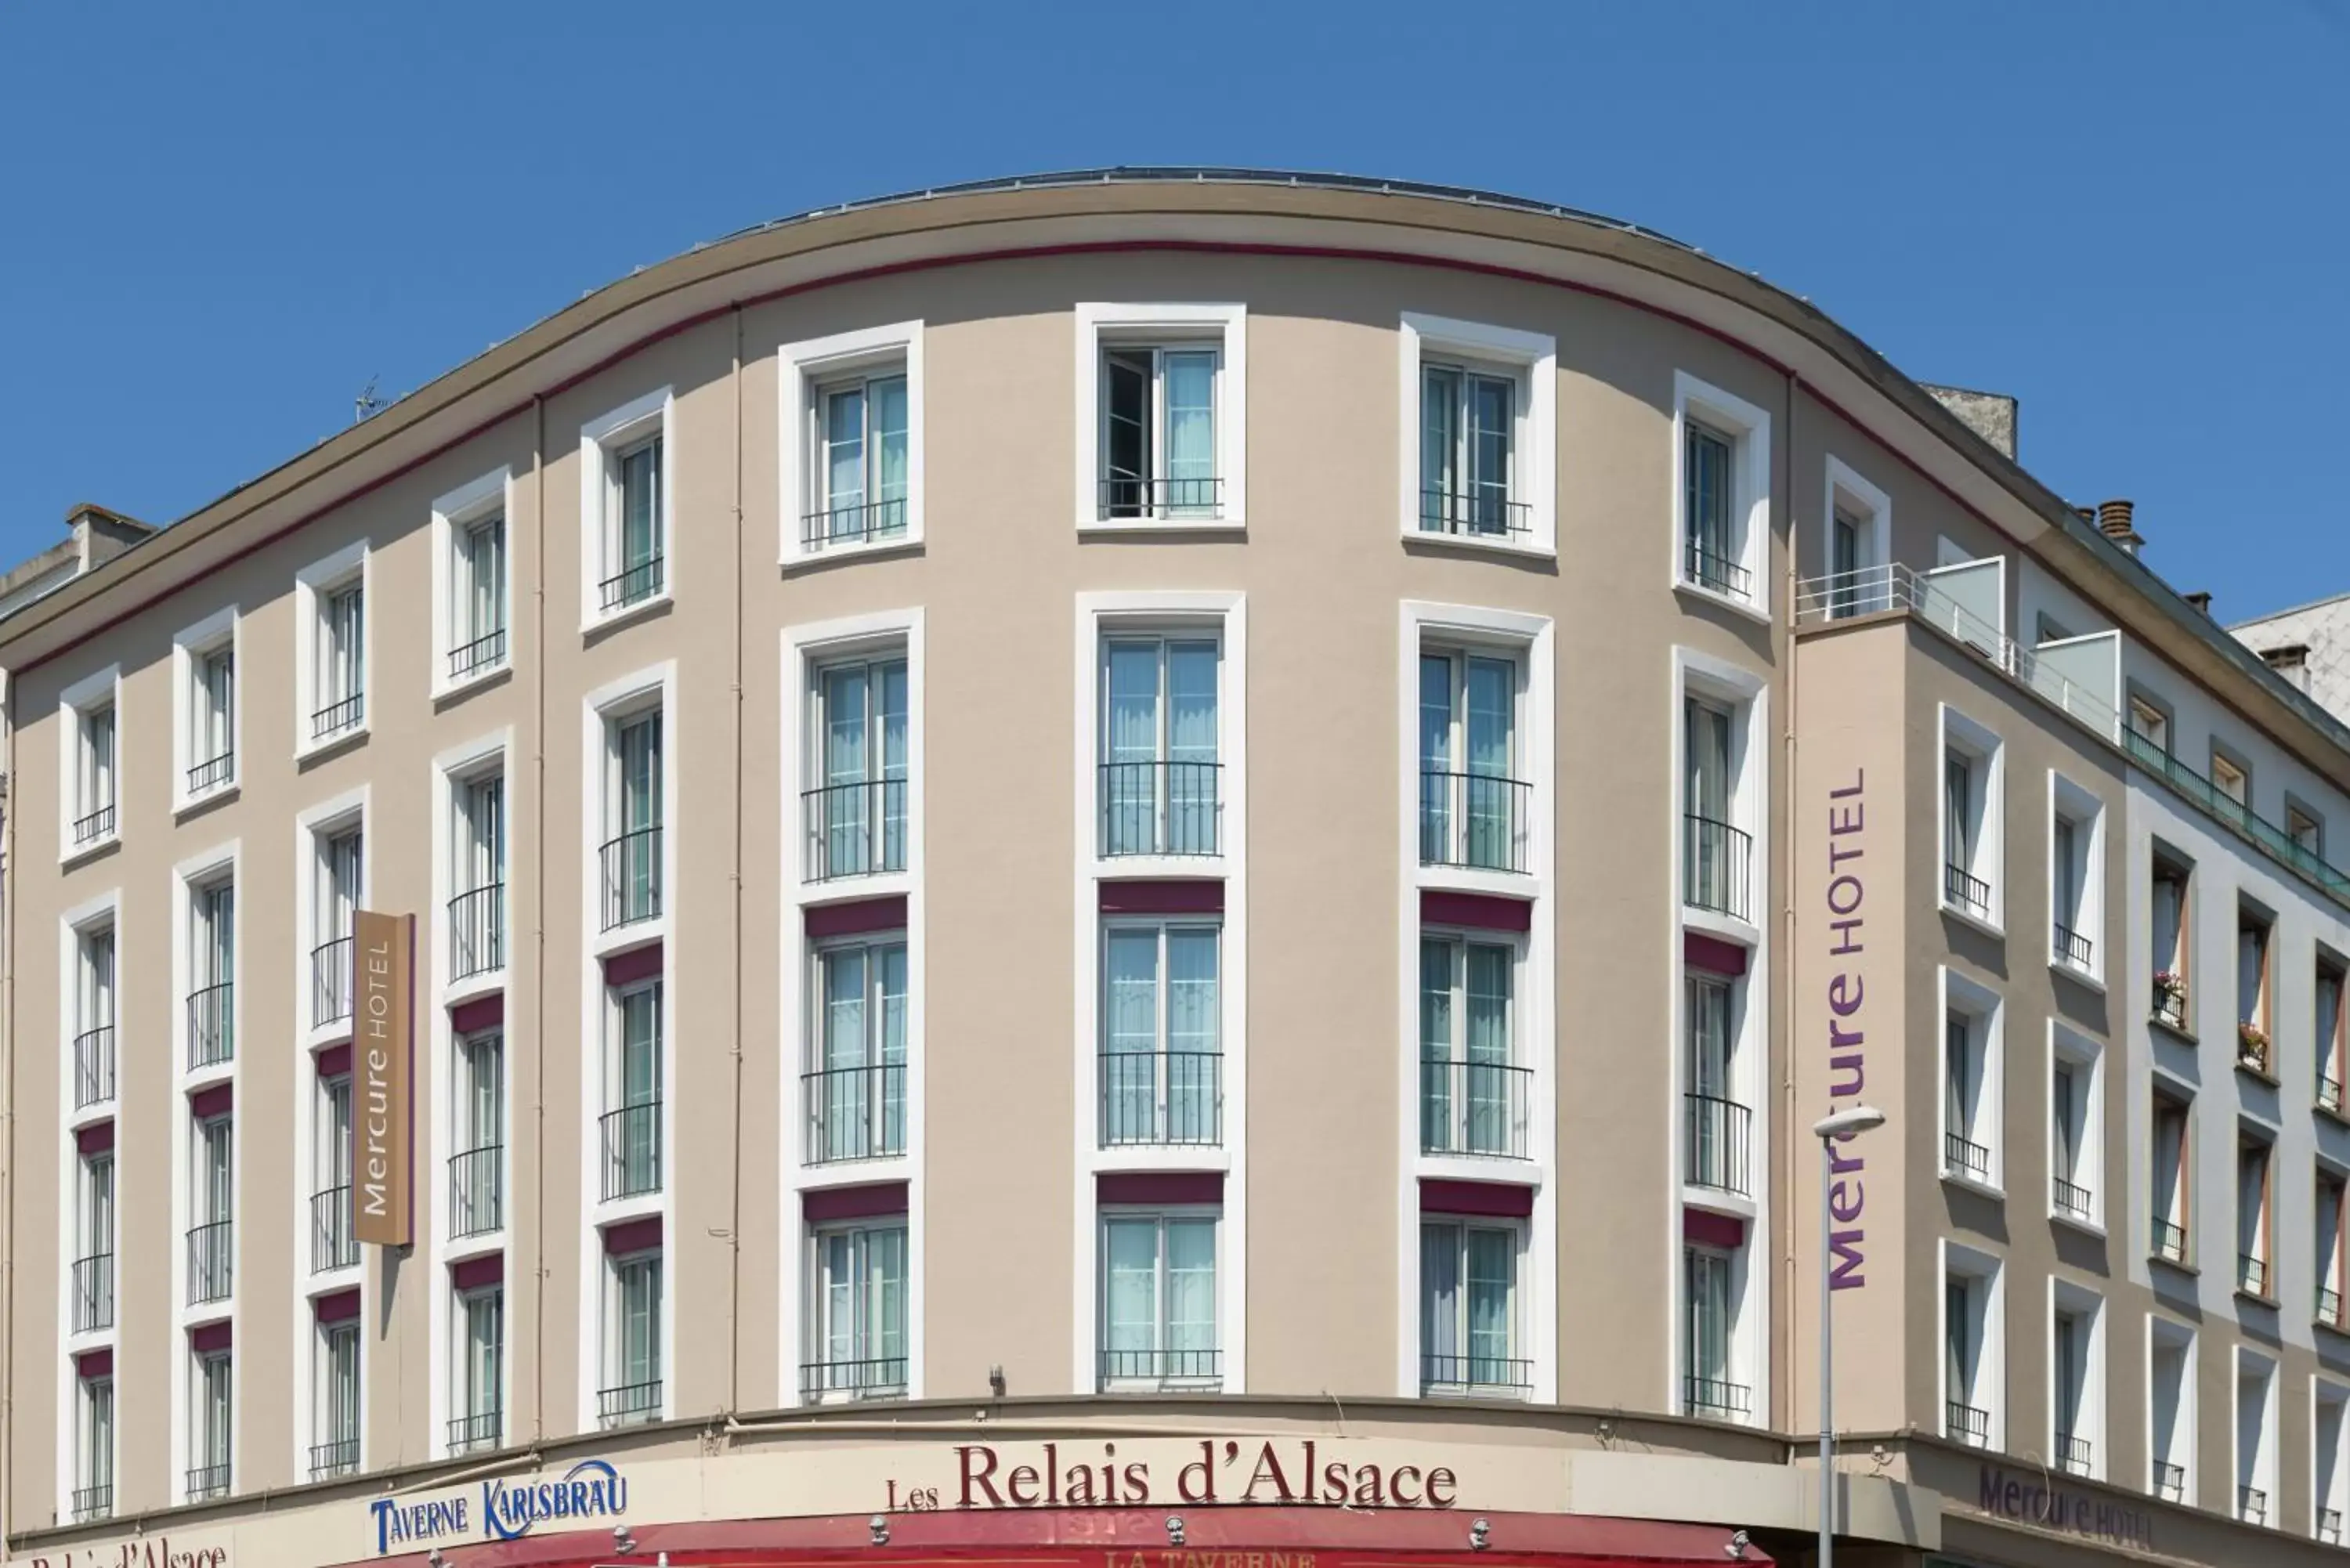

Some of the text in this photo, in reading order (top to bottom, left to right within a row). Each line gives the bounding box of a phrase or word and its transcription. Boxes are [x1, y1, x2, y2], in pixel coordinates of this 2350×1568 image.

[1828, 768, 1864, 1291] Merure HOTEL
[364, 941, 389, 1216] Mercure HOTEL
[887, 1440, 1458, 1511] Les Relais d'Alsace
[1979, 1463, 2092, 1538] Mercure
[371, 1498, 468, 1555] TAVERNE
[1104, 1550, 1317, 1568] LA TAVERNE
